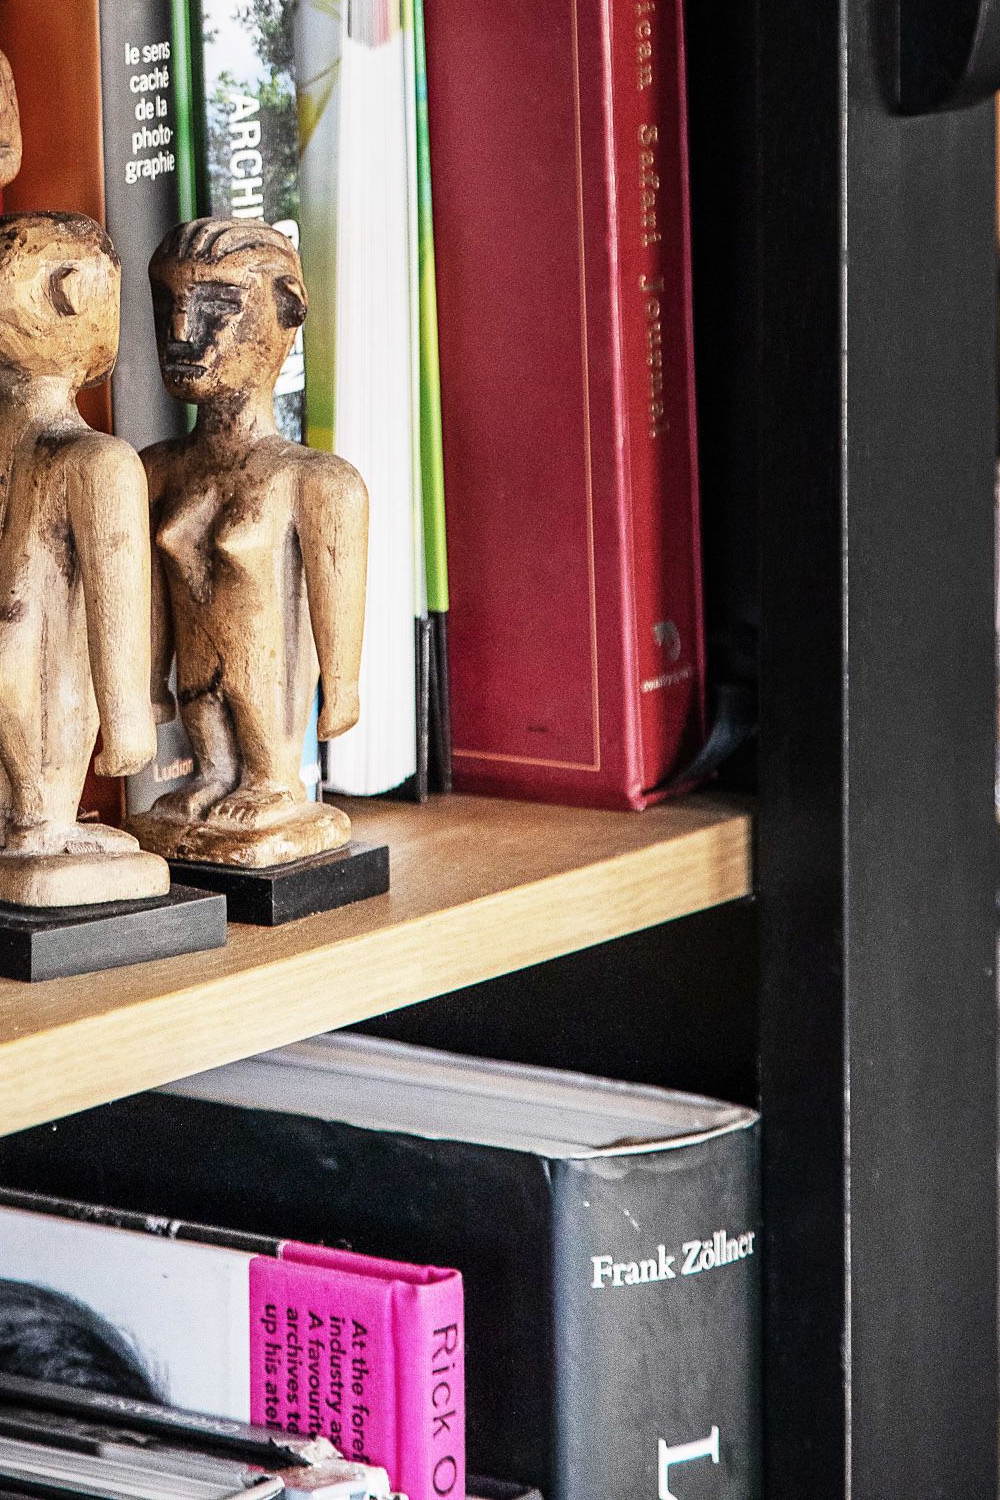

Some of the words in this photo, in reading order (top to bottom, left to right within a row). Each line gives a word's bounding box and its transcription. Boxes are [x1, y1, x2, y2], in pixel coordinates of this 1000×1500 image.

[124, 42, 140, 65] le
[142, 41, 171, 62] sens
[129, 65, 170, 94] caché
[135, 98, 154, 121] de
[155, 95, 168, 118] la
[131, 124, 174, 154] photo-
[228, 92, 265, 222] ARCHI
[124, 151, 175, 185] graphie
[639, 123, 662, 248] Safari
[639, 274, 670, 439] Journal
[590, 1243, 676, 1289] Frank
[680, 1229, 756, 1276] Zöllner
[260, 1304, 279, 1335] up
[308, 1310, 324, 1330] A
[351, 1319, 368, 1350] At
[265, 1342, 281, 1375] his
[286, 1307, 302, 1404] archives
[326, 1315, 346, 1414] industry
[351, 1358, 369, 1396] the
[431, 1323, 458, 1439] Rick
[265, 1381, 281, 1430] atel
[351, 1404, 370, 1463] foref
